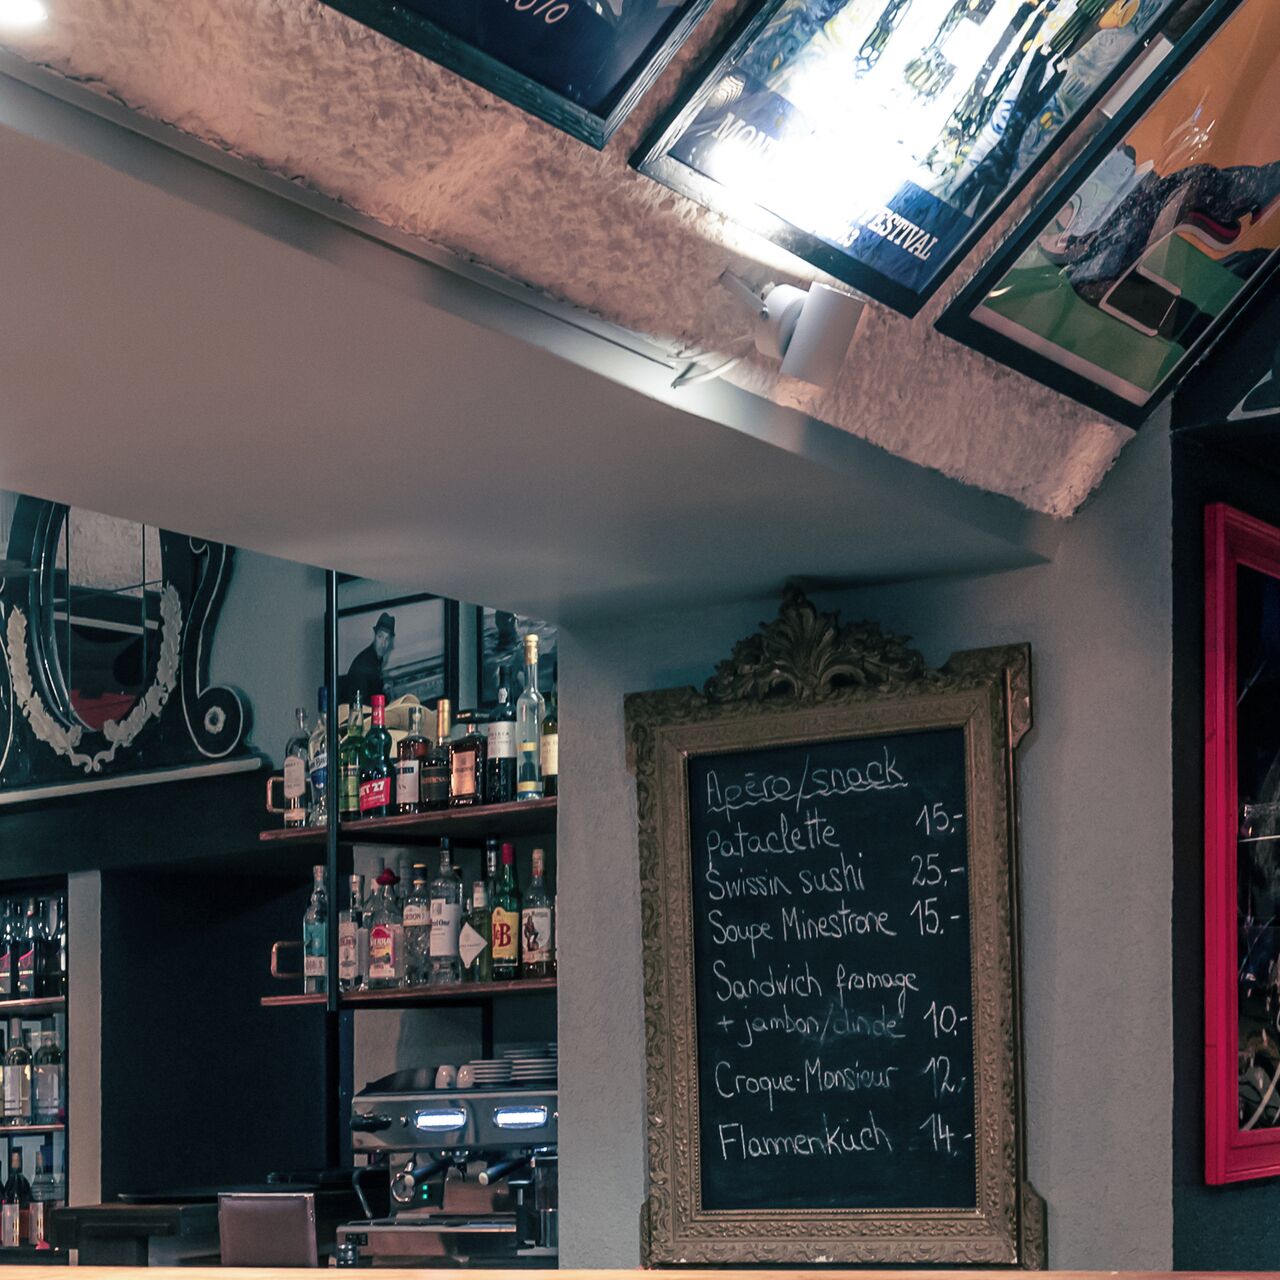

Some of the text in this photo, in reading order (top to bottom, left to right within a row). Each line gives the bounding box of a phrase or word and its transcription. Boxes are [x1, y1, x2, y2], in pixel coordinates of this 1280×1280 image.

[372, 781, 385, 792] 27
[799, 852, 865, 894] sushi
[708, 909, 773, 959] Soupe
[781, 899, 897, 941] Minestrone
[713, 960, 920, 1018] Sandwich fromage
